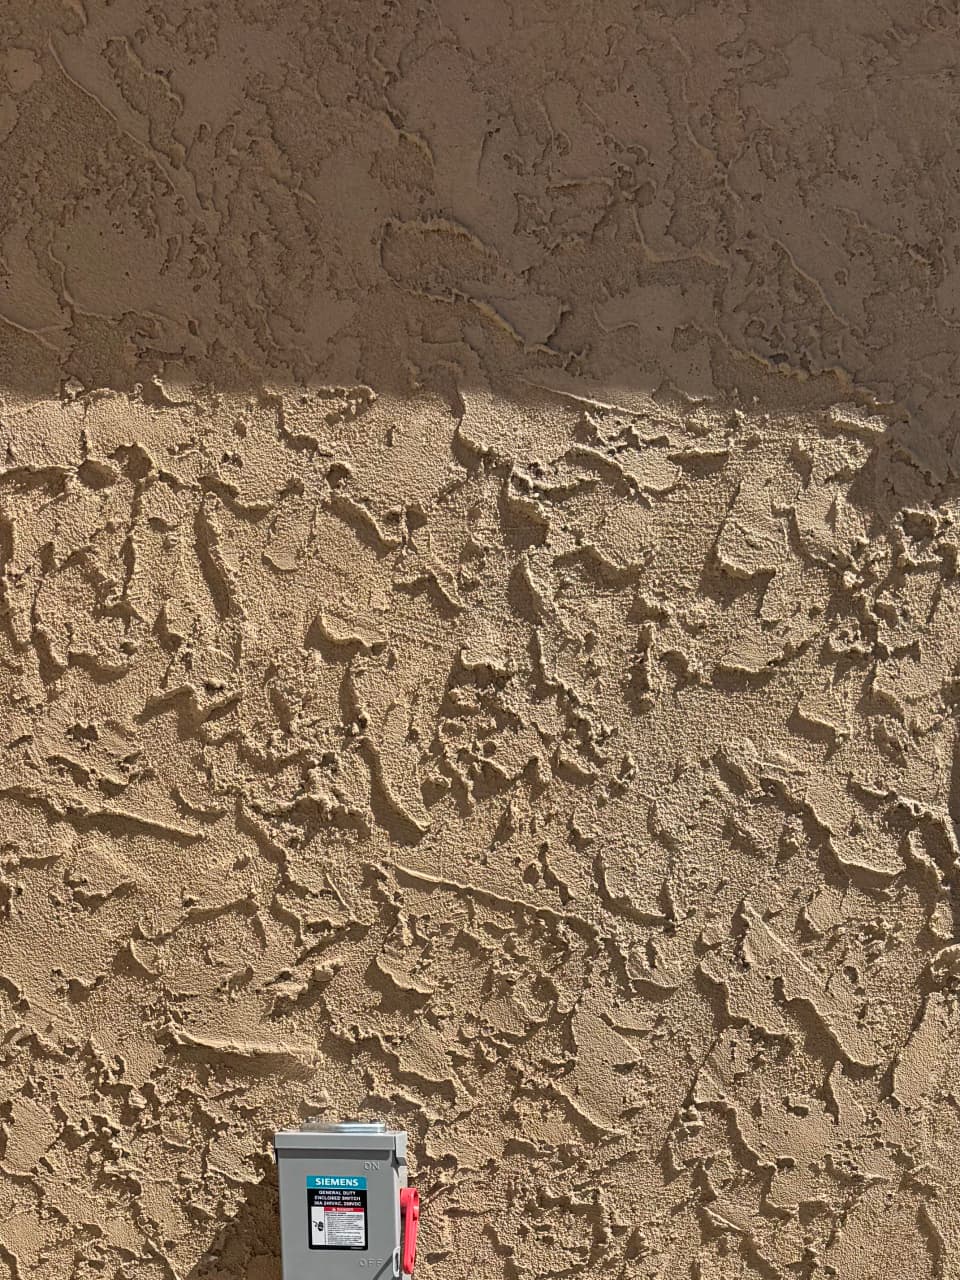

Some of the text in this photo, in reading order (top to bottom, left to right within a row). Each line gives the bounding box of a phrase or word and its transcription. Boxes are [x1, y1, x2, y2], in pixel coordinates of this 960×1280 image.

[363, 1161, 380, 1171] ON
[315, 1177, 359, 1187] SIEMENS
[359, 1258, 385, 1267] OFF
